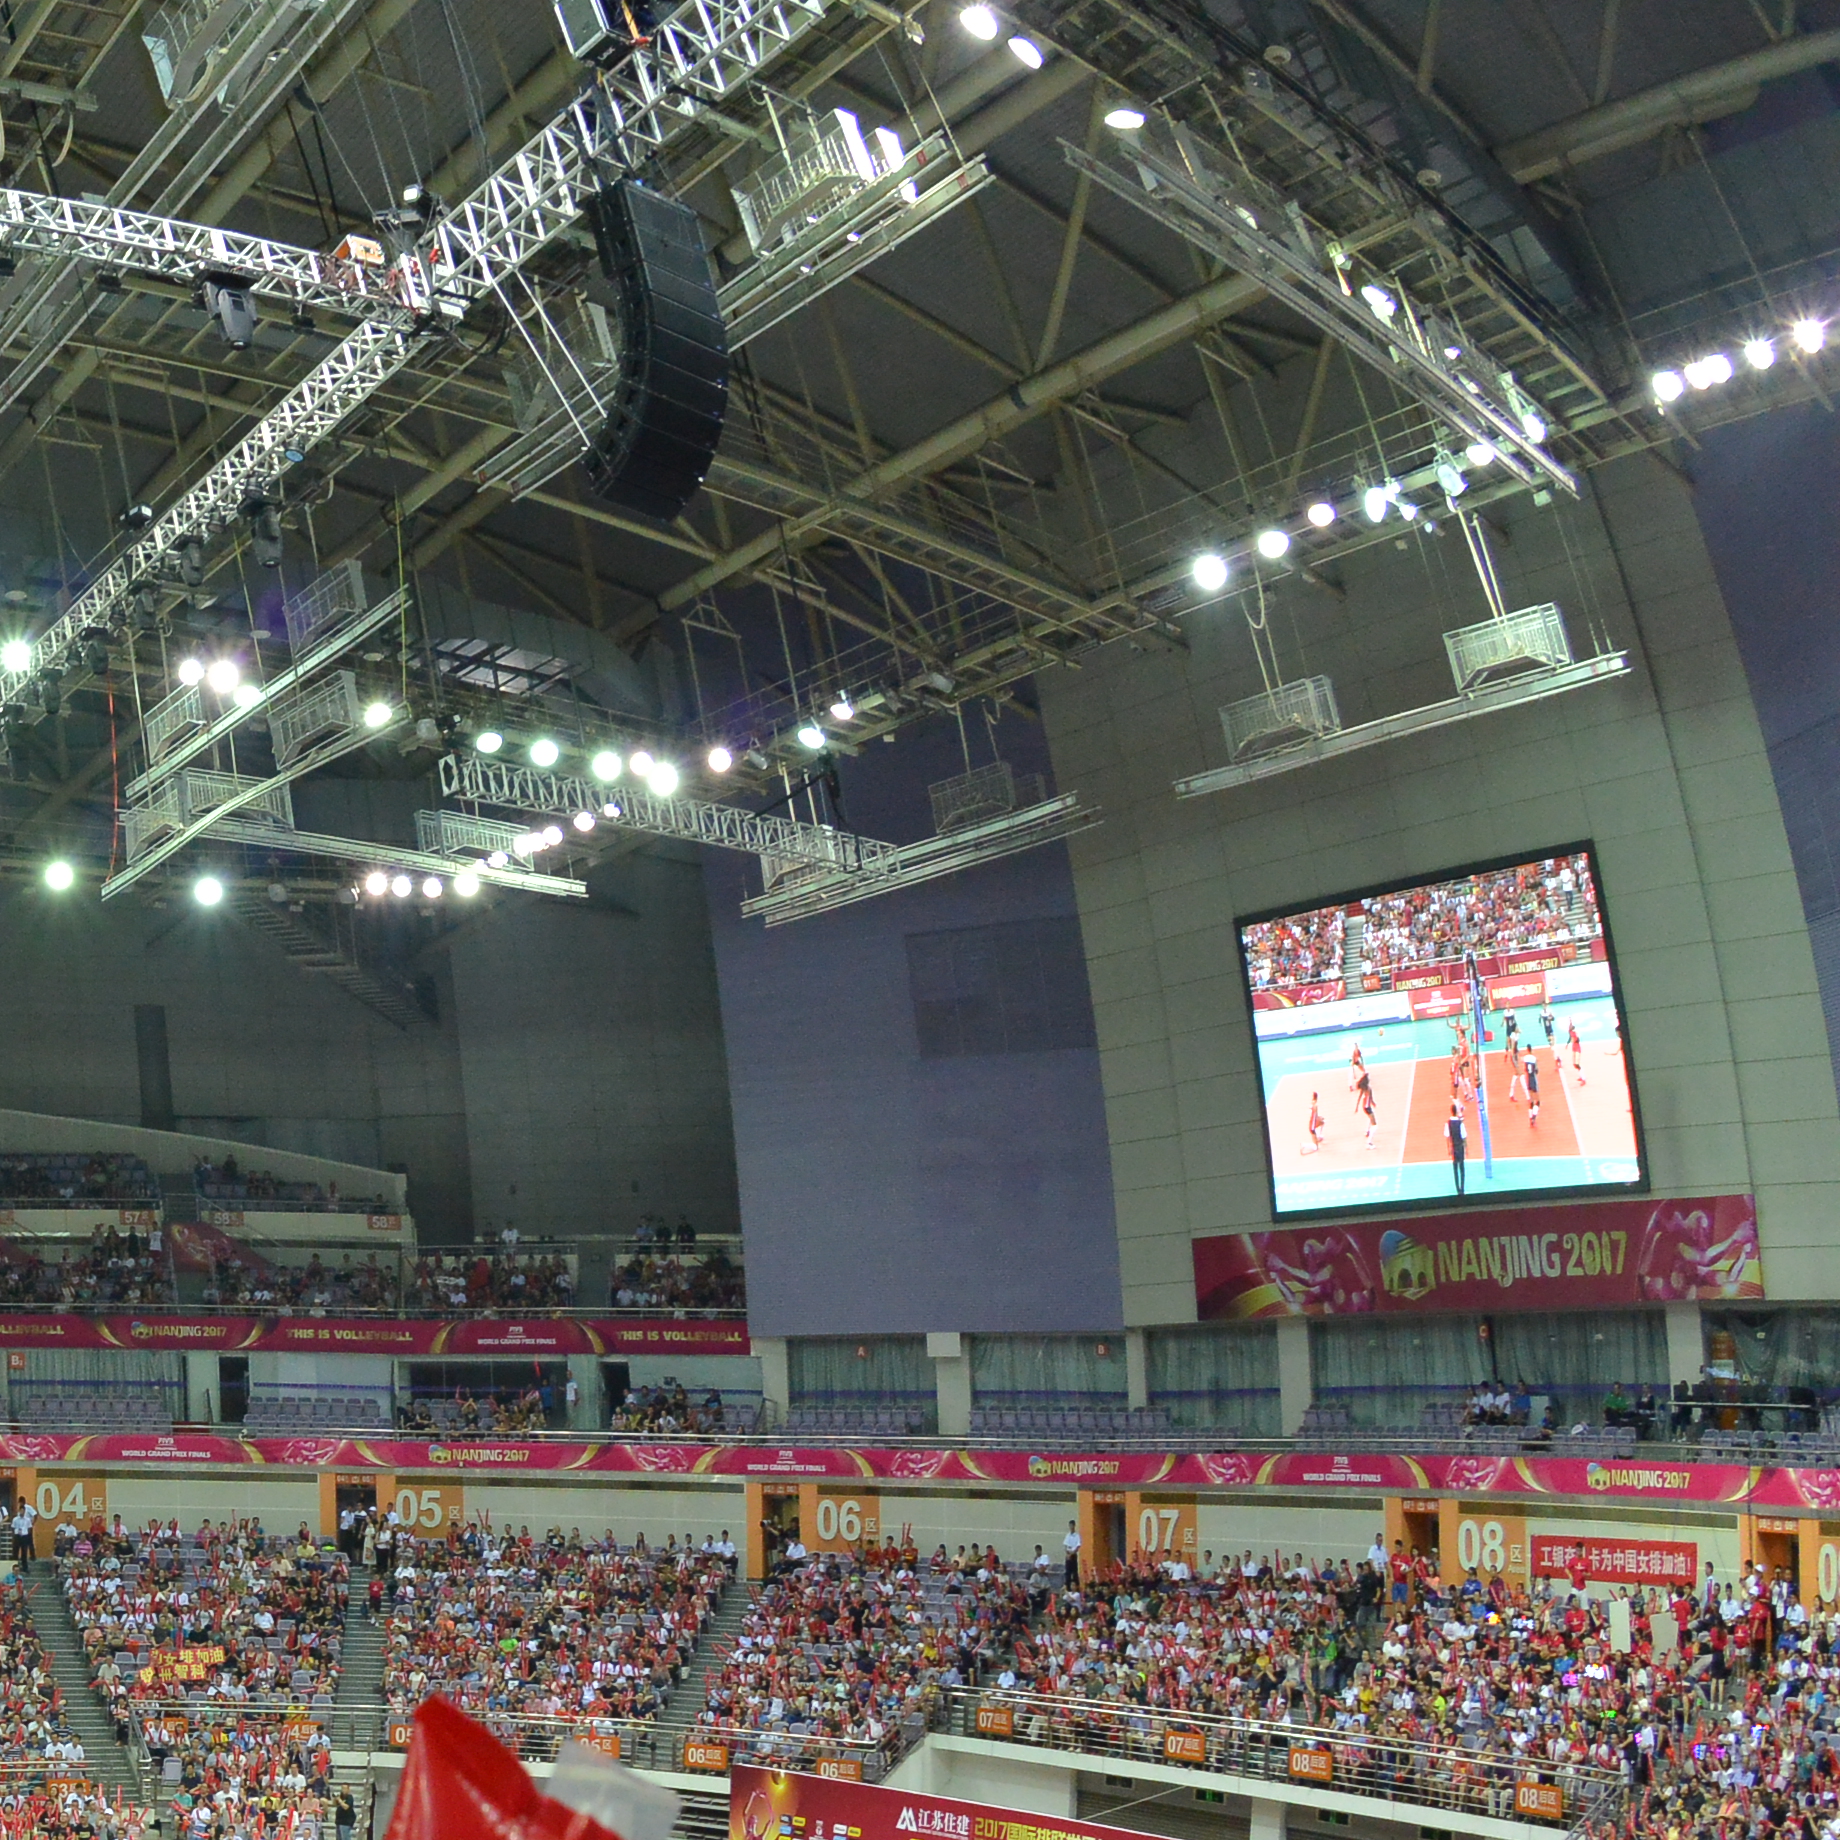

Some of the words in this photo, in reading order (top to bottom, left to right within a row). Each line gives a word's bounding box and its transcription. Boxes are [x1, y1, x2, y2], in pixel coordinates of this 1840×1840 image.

[1437, 1233, 1561, 1287] NANJING
[1563, 1231, 1627, 1276] 2017
[36, 1482, 87, 1520] 04
[395, 1490, 442, 1528] 05
[817, 1499, 861, 1541] 06
[1139, 1509, 1179, 1552] 07
[1458, 1520, 1505, 1573] 08
[1540, 1546, 1691, 1576] 工银卡为中国女排加油!
[979, 1711, 993, 1728] 07
[820, 1762, 838, 1777] 06
[918, 1808, 970, 1835] 江苏住建
